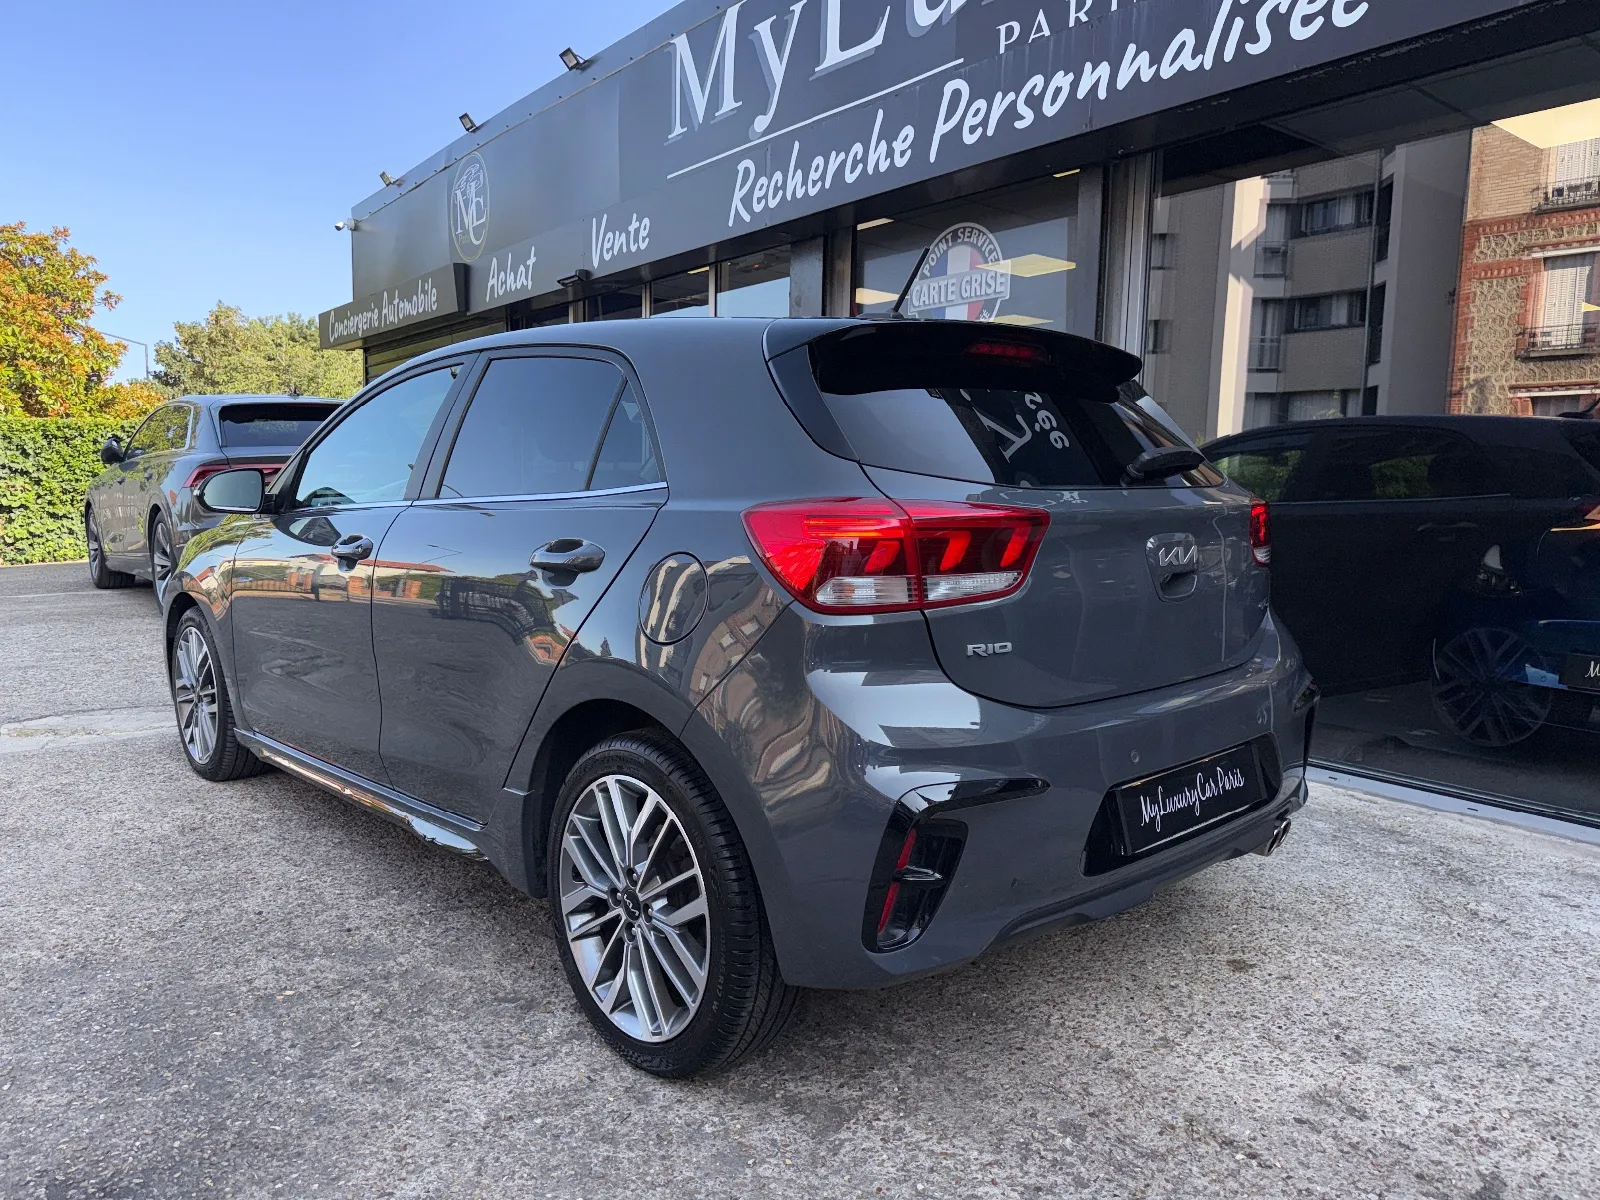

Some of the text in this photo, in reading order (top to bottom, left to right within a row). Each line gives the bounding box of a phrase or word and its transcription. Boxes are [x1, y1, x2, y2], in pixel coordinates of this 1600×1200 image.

[729, 109, 915, 228] Recherche
[591, 213, 650, 269] Vente
[922, 227, 998, 277] POINT SERVICE
[487, 246, 537, 302] Achat
[912, 270, 1005, 307] CARTE GRISE
[328, 278, 438, 343] Conciergerie Automobile
[966, 641, 1013, 657] RIO
[1140, 766, 1245, 833] MyLuxuryCar Paris
